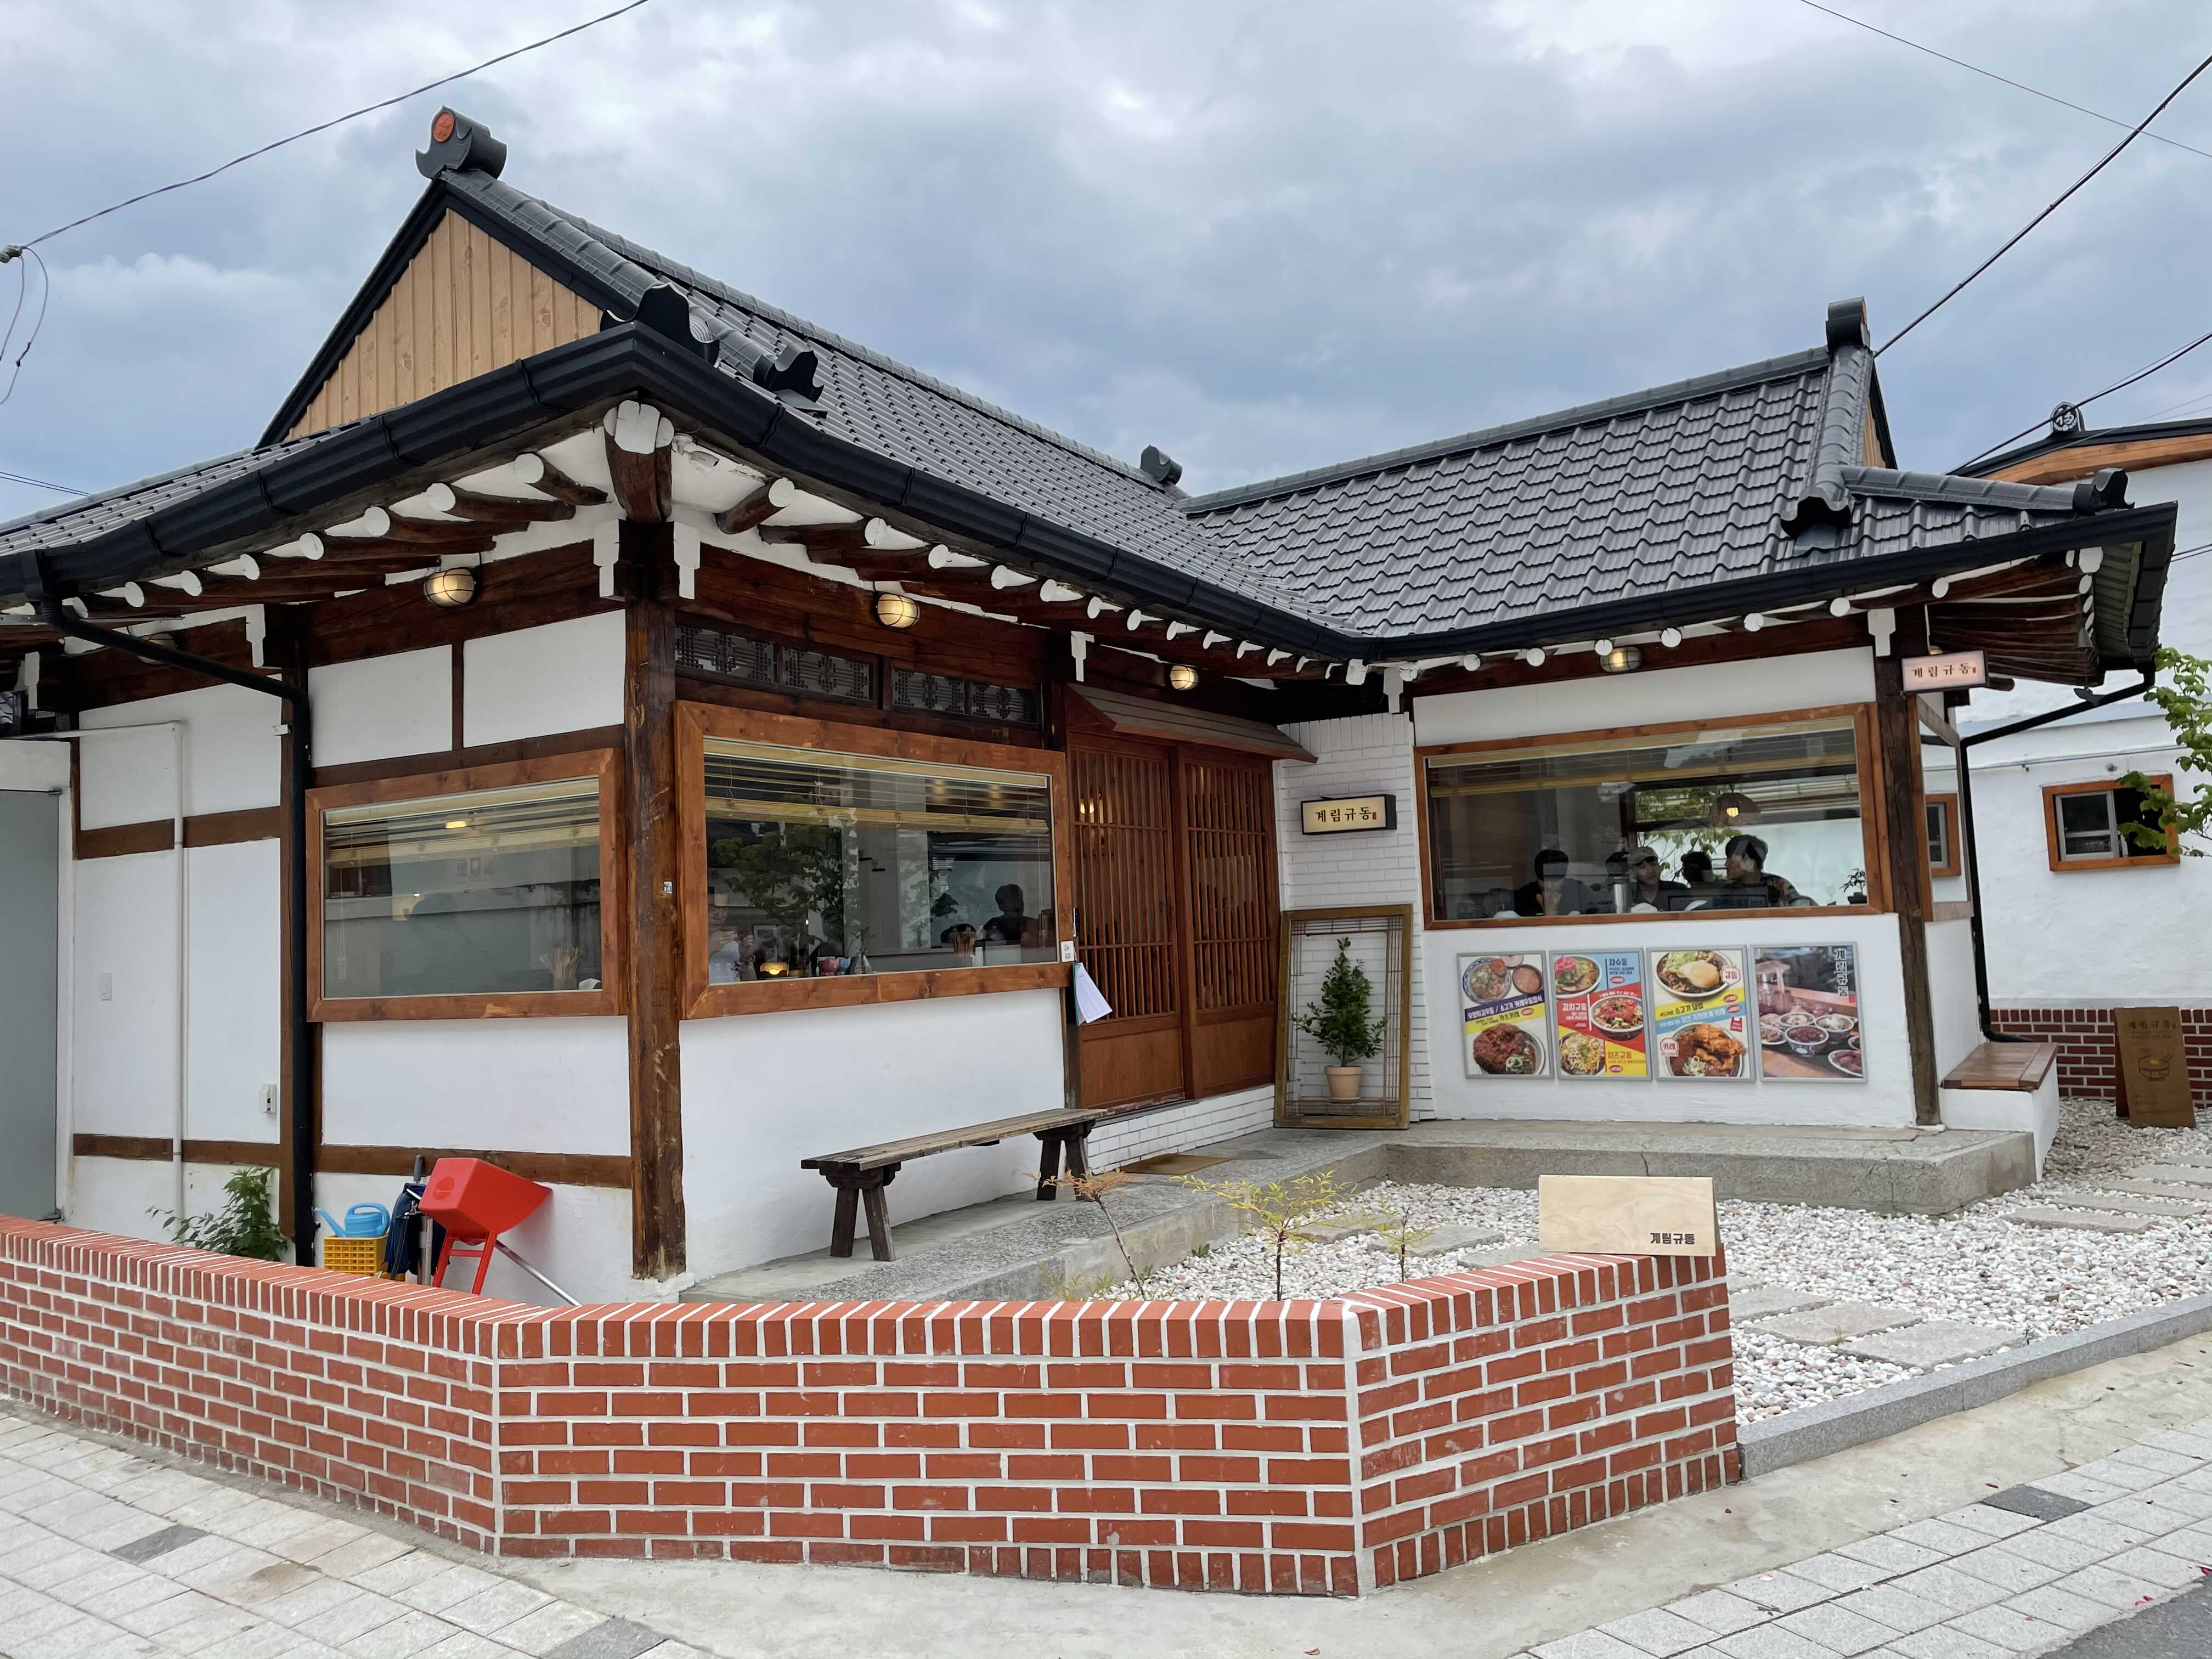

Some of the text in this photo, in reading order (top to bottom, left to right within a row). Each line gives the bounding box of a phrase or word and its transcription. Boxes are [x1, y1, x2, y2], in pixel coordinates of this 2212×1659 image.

[1912, 663, 1971, 678] 계림규동
[1314, 806, 1372, 822] 계림규동
[1835, 948, 1849, 997] 계림규동
[1500, 1002, 1514, 1012] 소고기
[1562, 1002, 1587, 1012] 김치규동
[1675, 1005, 1691, 1014] 소고기
[1650, 1232, 1695, 1245] 계림규동
